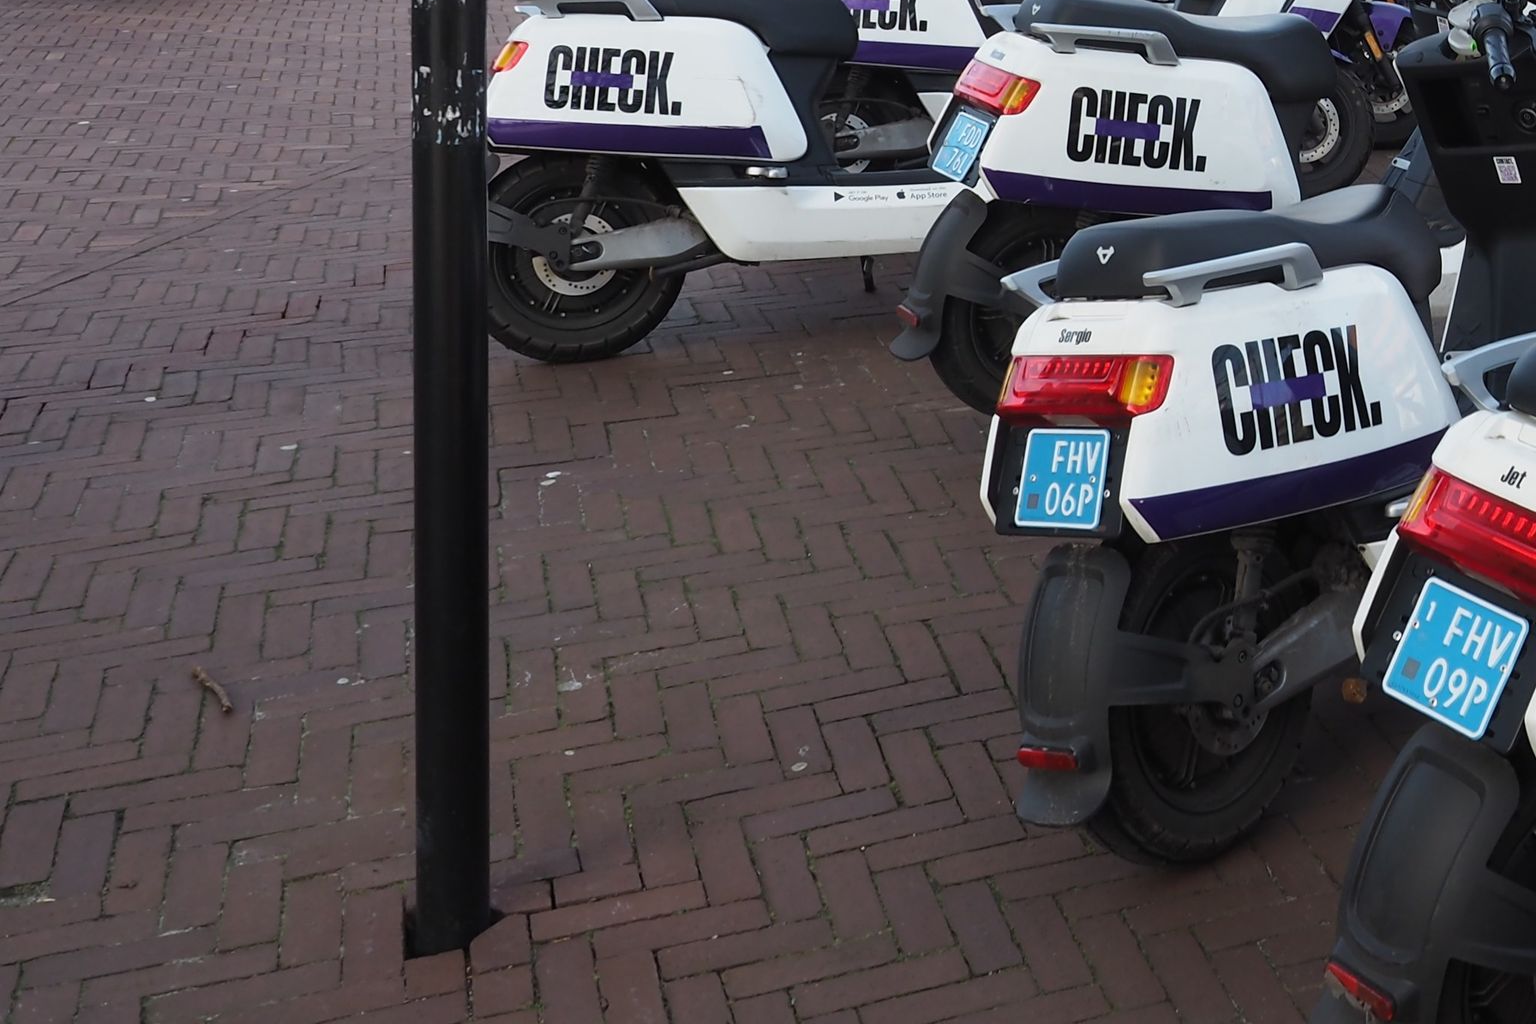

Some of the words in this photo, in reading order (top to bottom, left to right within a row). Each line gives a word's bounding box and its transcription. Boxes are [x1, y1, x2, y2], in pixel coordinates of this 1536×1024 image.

[544, 45, 682, 116] CHECK.
[1067, 87, 1207, 172] CHECK.
[911, 192, 926, 200] App
[1058, 327, 1092, 346] Sergio
[1212, 325, 1383, 456] CHECK.
[1051, 440, 1101, 474] FHV
[1500, 465, 1527, 490] Jet
[1045, 482, 1093, 517] 06P
[1426, 601, 1437, 621] 1
[1442, 606, 1515, 668] FHV
[1423, 657, 1488, 717] 09P
